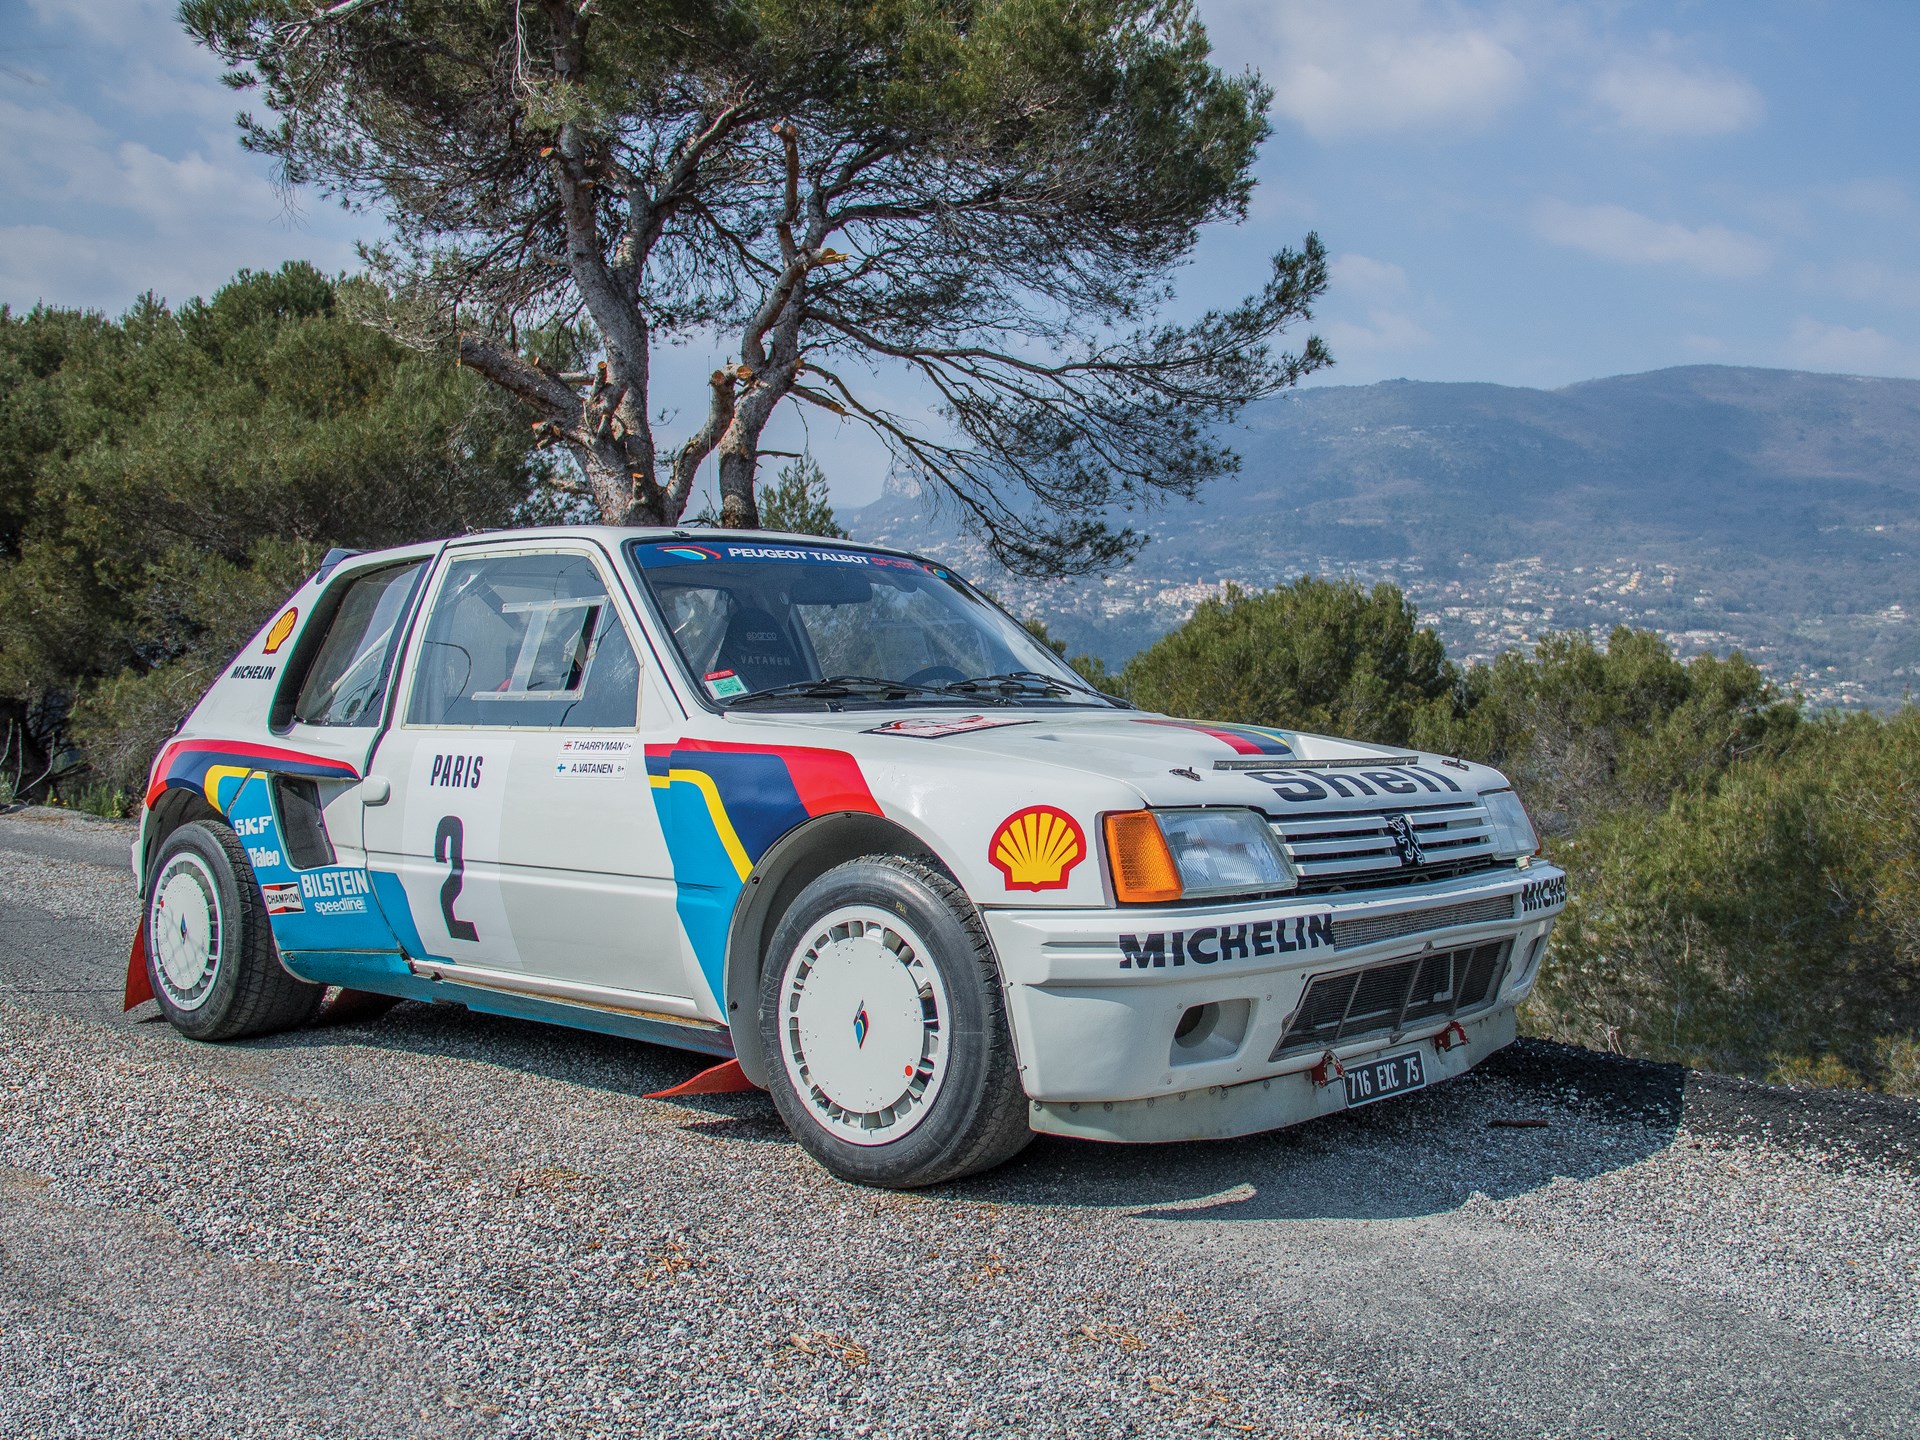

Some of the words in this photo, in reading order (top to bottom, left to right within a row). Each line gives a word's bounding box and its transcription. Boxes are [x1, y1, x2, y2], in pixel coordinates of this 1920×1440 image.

[728, 548, 807, 560] PEUGEOT
[810, 552, 869, 564] TALBOT
[870, 556, 915, 570] SPORT
[740, 655, 790, 666] VATANEN
[231, 665, 277, 680] MICHELIN
[573, 741, 624, 751] T.HARRYMAN
[430, 755, 484, 789] PARIS
[571, 763, 614, 773] A.VATANEN
[1244, 766, 1463, 802] Shell
[234, 816, 272, 836] SKF
[248, 847, 280, 867] Valeo
[301, 870, 369, 898] BILSTEIN
[434, 815, 480, 942] 2
[266, 893, 301, 905] CHAMPION
[314, 896, 363, 914] speedline
[1119, 913, 1335, 969] MICHELIN
[1348, 1069, 1371, 1099] 716
[1376, 1062, 1399, 1091] EXC
[1403, 1056, 1419, 1083] 75
